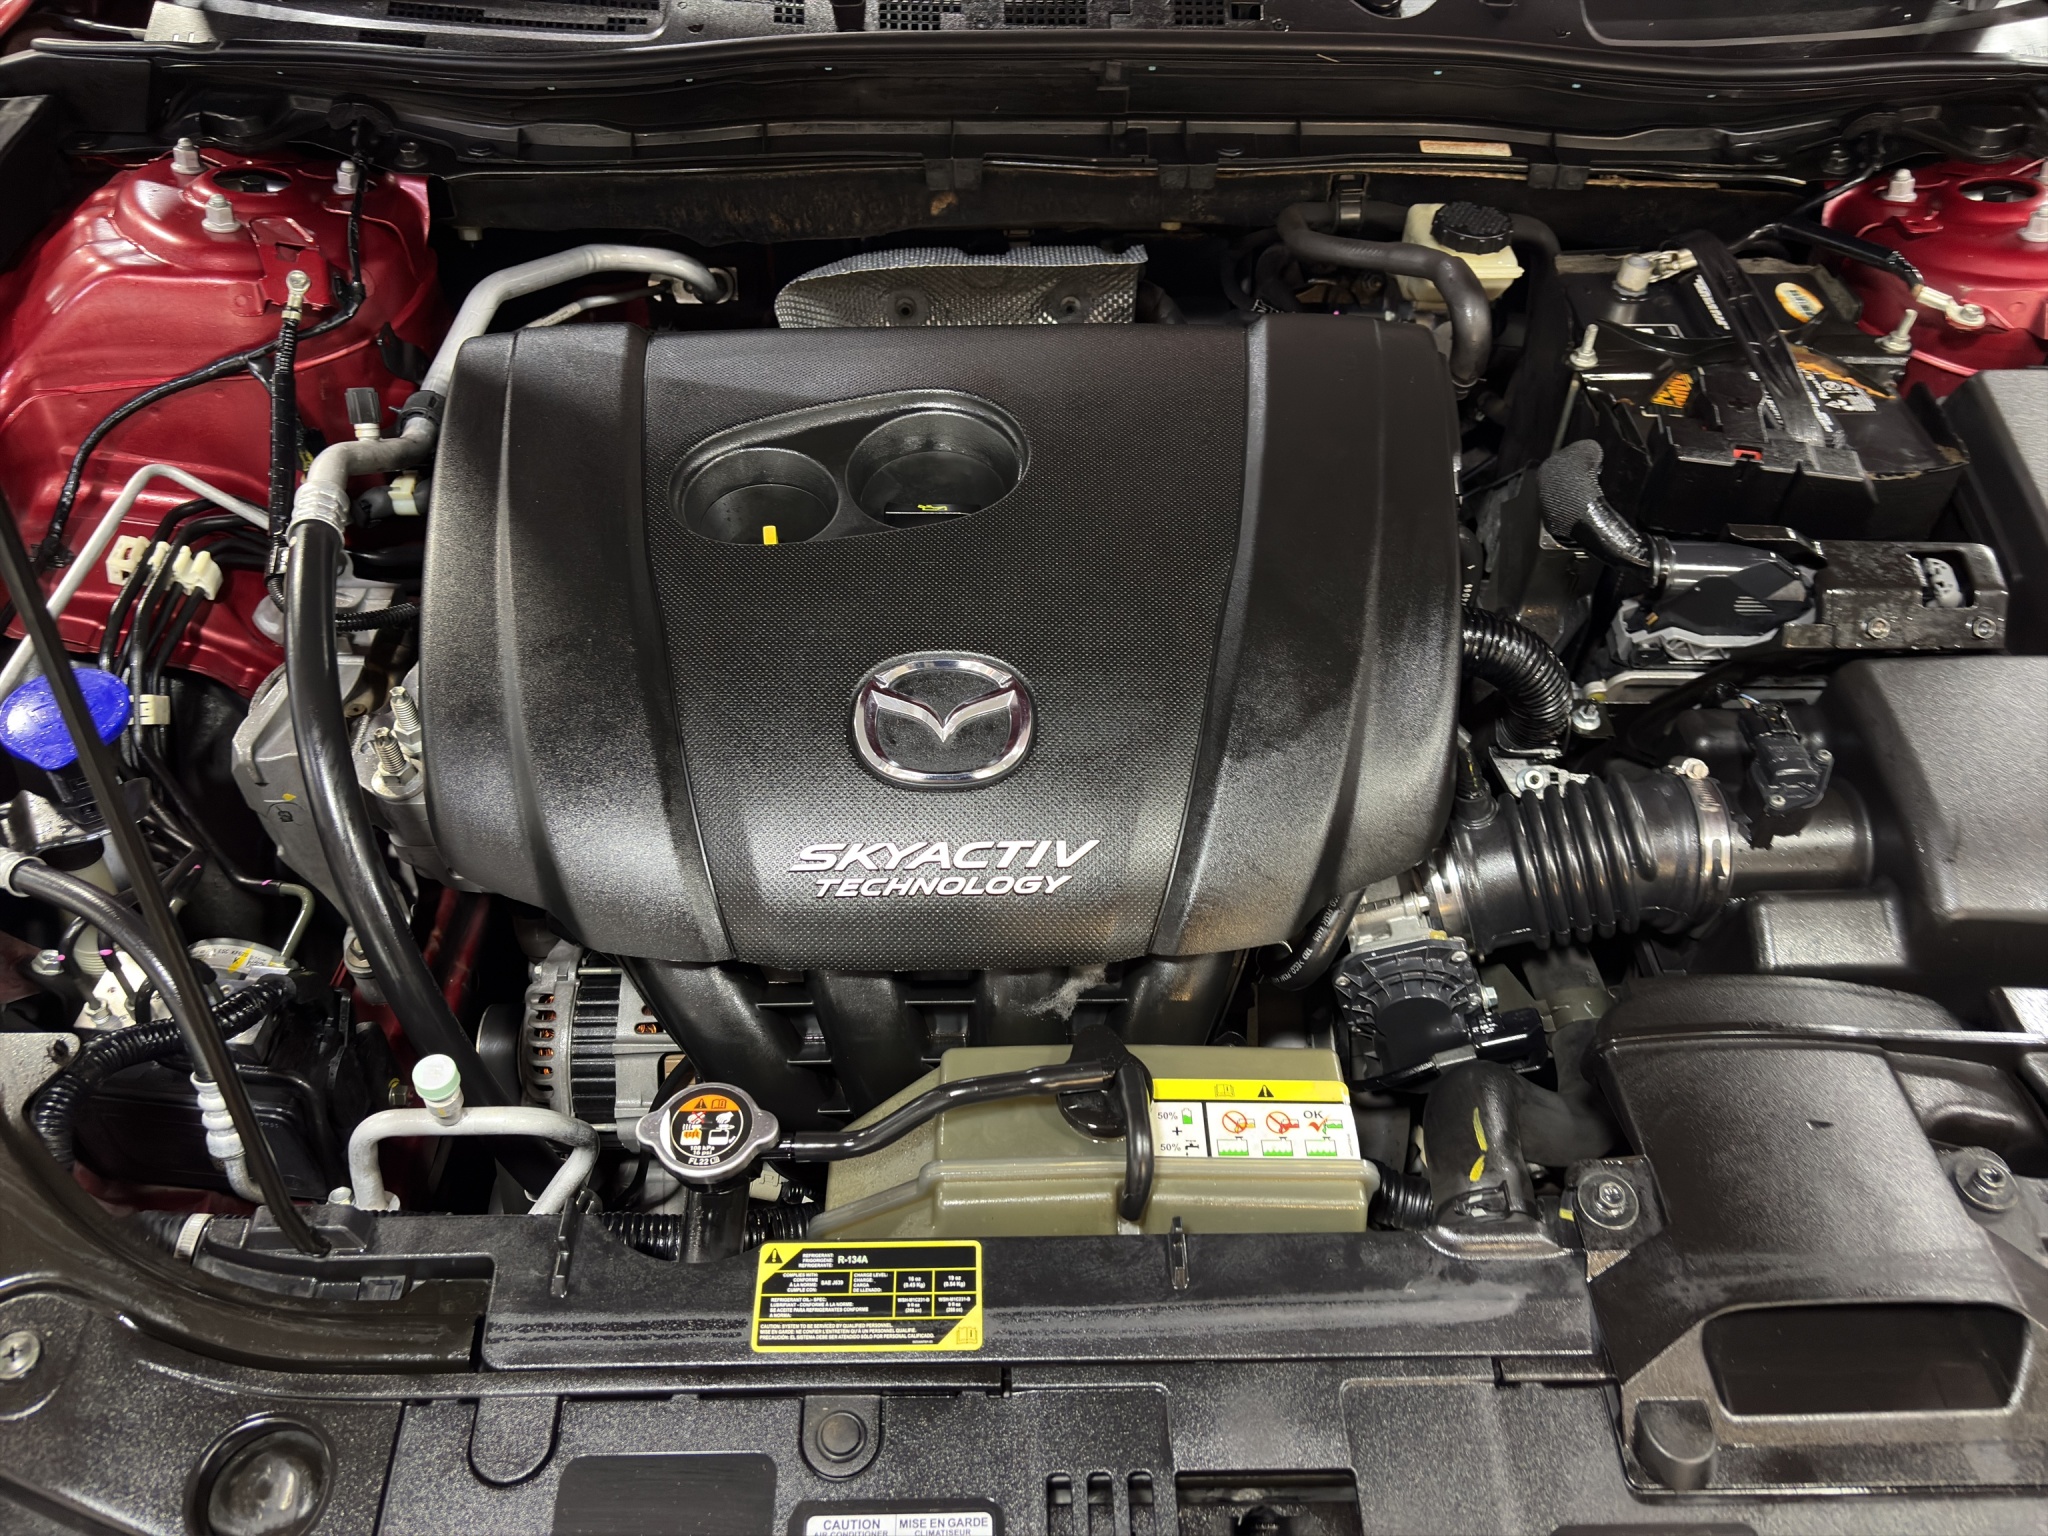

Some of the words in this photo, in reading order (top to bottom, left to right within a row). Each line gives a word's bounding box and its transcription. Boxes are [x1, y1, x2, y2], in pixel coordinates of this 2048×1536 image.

[788, 840, 1100, 872] SKYACTIV
[815, 875, 1073, 898] TECHNOLOGY
[1158, 1112, 1178, 1120] 50%
[1303, 1110, 1323, 1119] OK
[838, 1255, 868, 1264] R-134A
[823, 1519, 880, 1530] CAUTION
[900, 1518, 926, 1528] MISE
[930, 1518, 945, 1528] EN
[948, 1517, 988, 1527] GARDE
